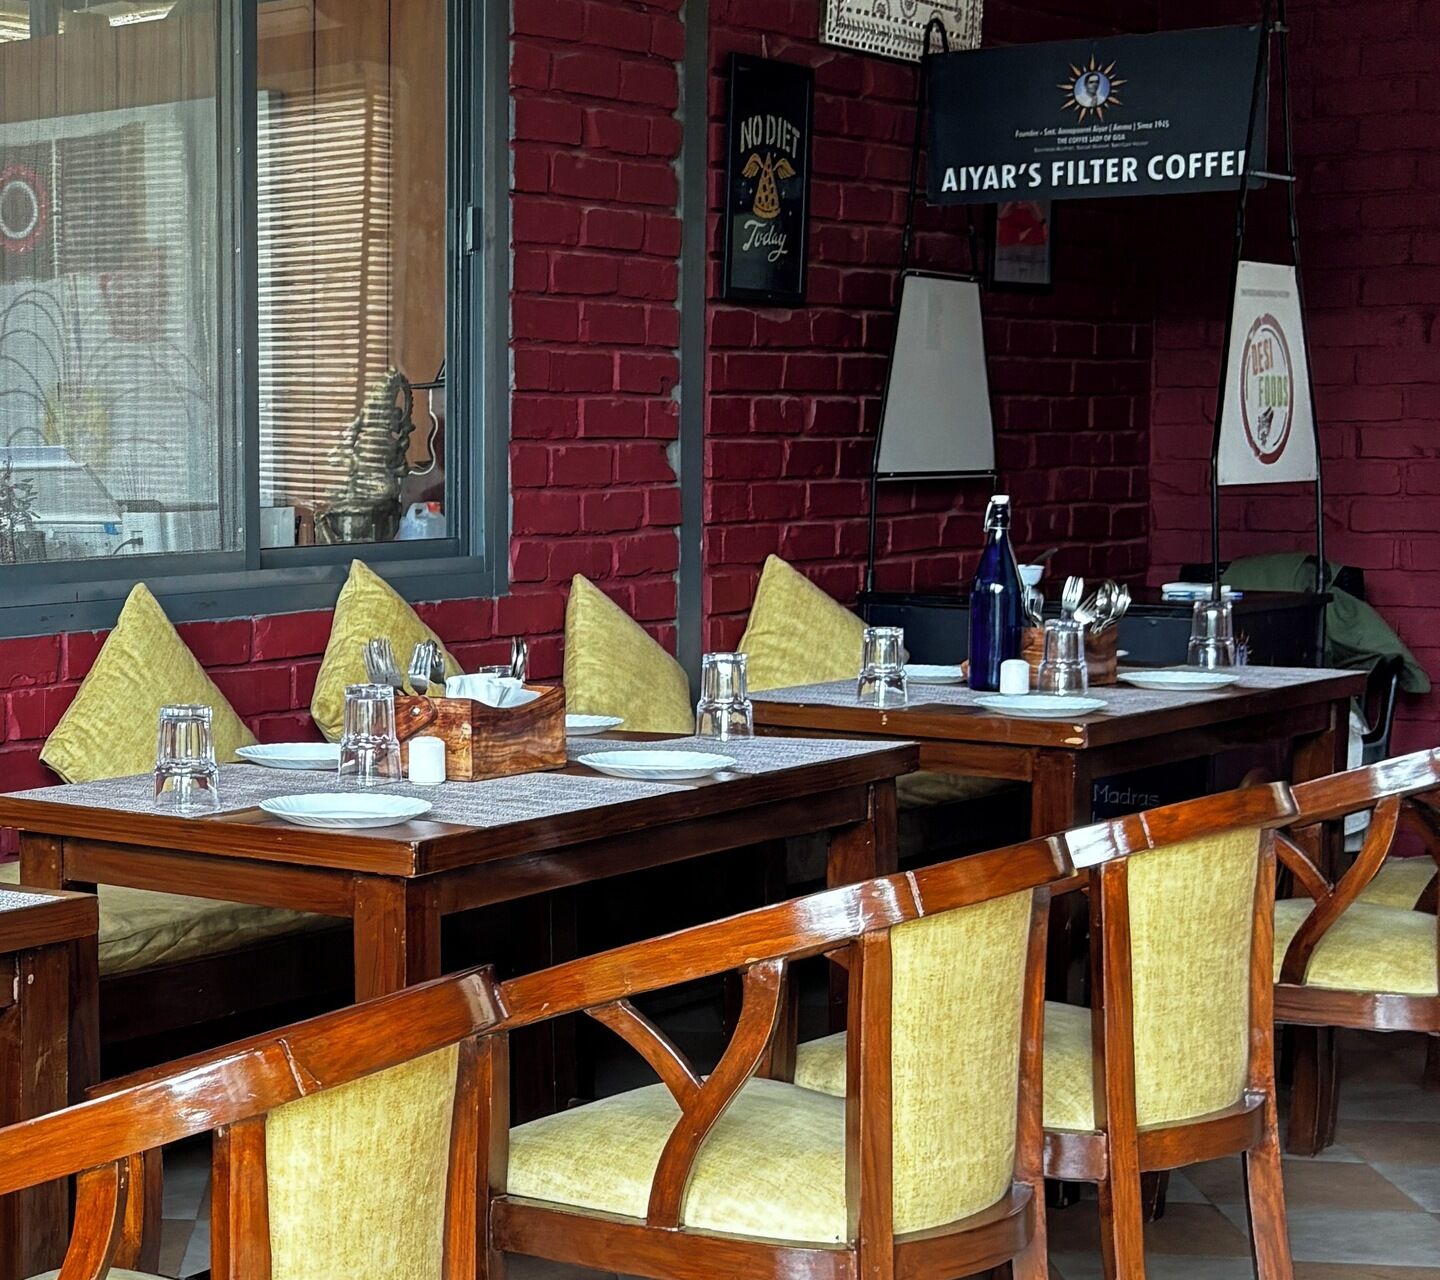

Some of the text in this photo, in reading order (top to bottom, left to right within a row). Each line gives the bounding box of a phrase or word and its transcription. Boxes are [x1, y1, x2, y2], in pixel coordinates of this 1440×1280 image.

[739, 114, 801, 159] NO DIET
[941, 163, 1042, 192] AIYAR'S
[1051, 157, 1138, 187] FILTER
[742, 219, 788, 263] Today
[1251, 337, 1273, 376] DESI
[1258, 375, 1288, 408] FOODS
[1093, 784, 1159, 807] Madras
